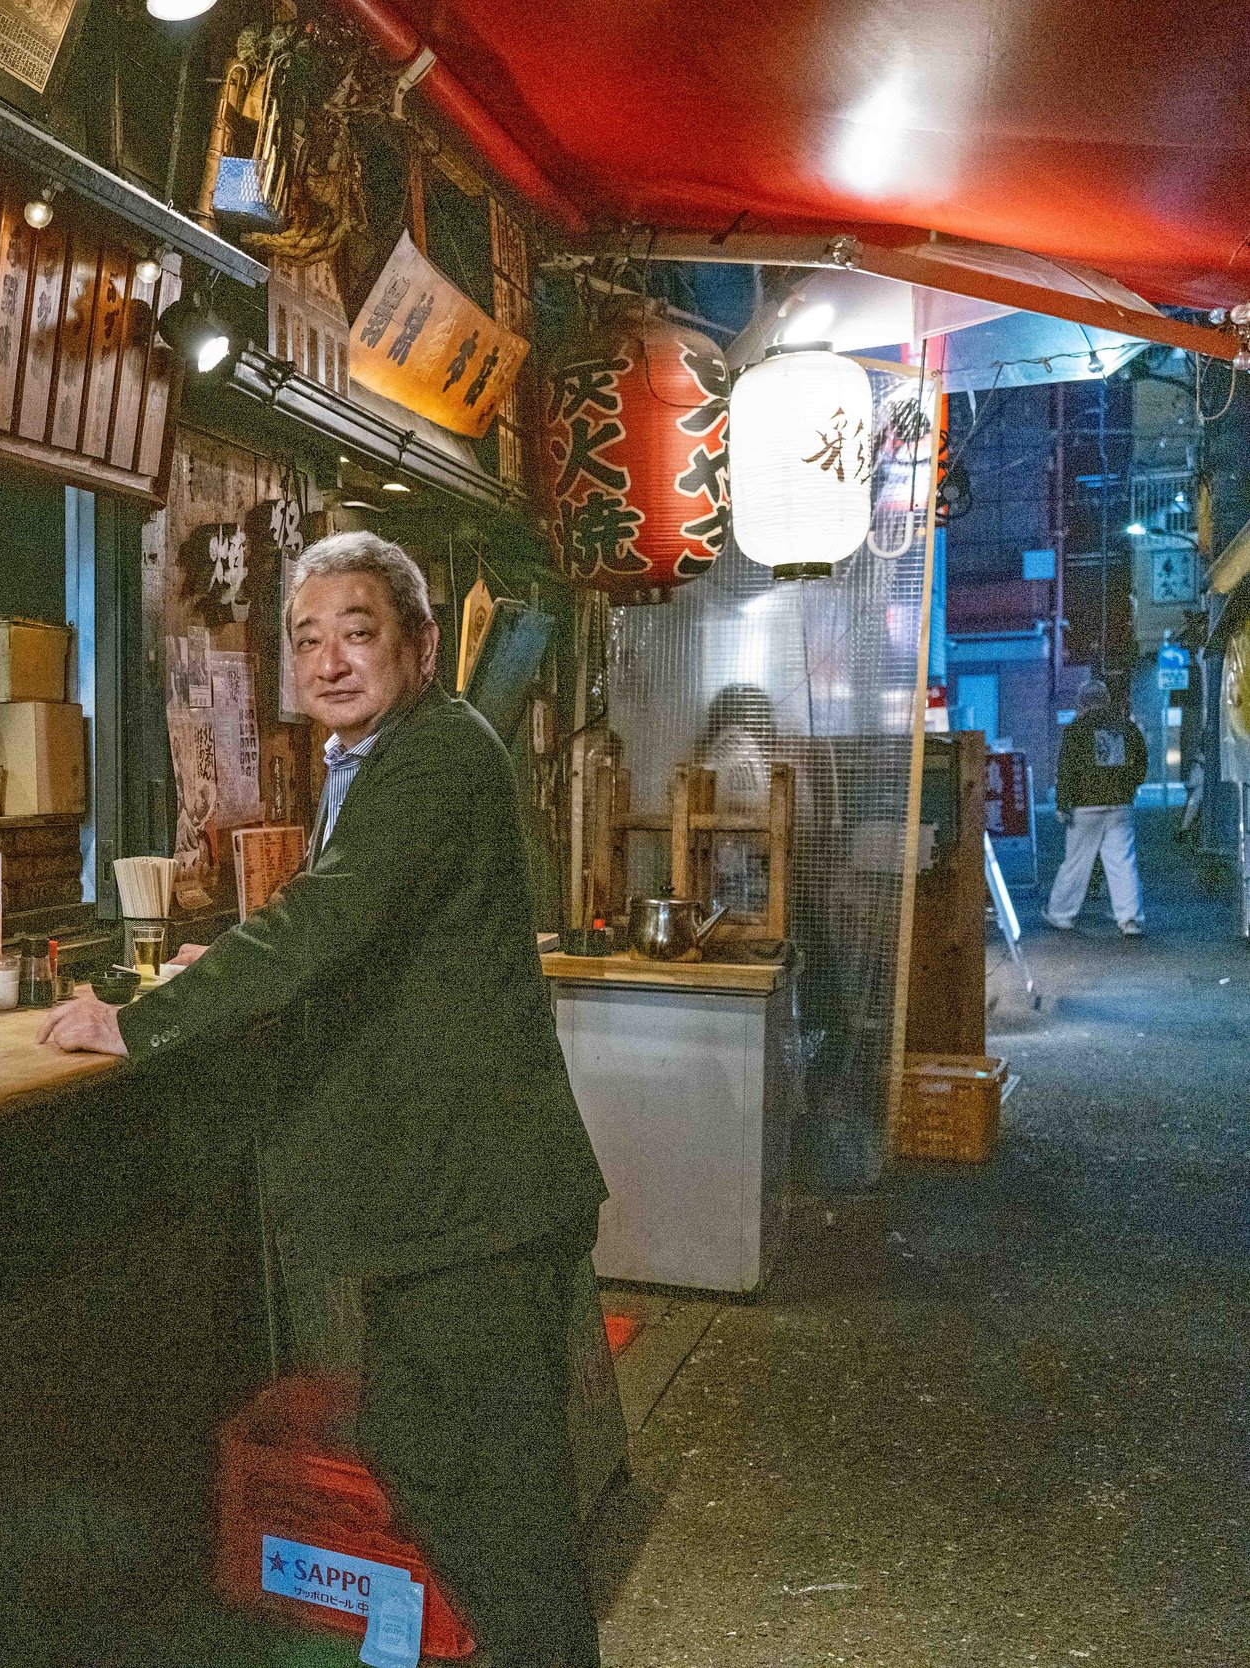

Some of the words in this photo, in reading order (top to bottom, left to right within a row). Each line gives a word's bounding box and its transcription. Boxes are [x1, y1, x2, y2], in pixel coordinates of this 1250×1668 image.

[294, 1586, 354, 1610] サッポロビール
